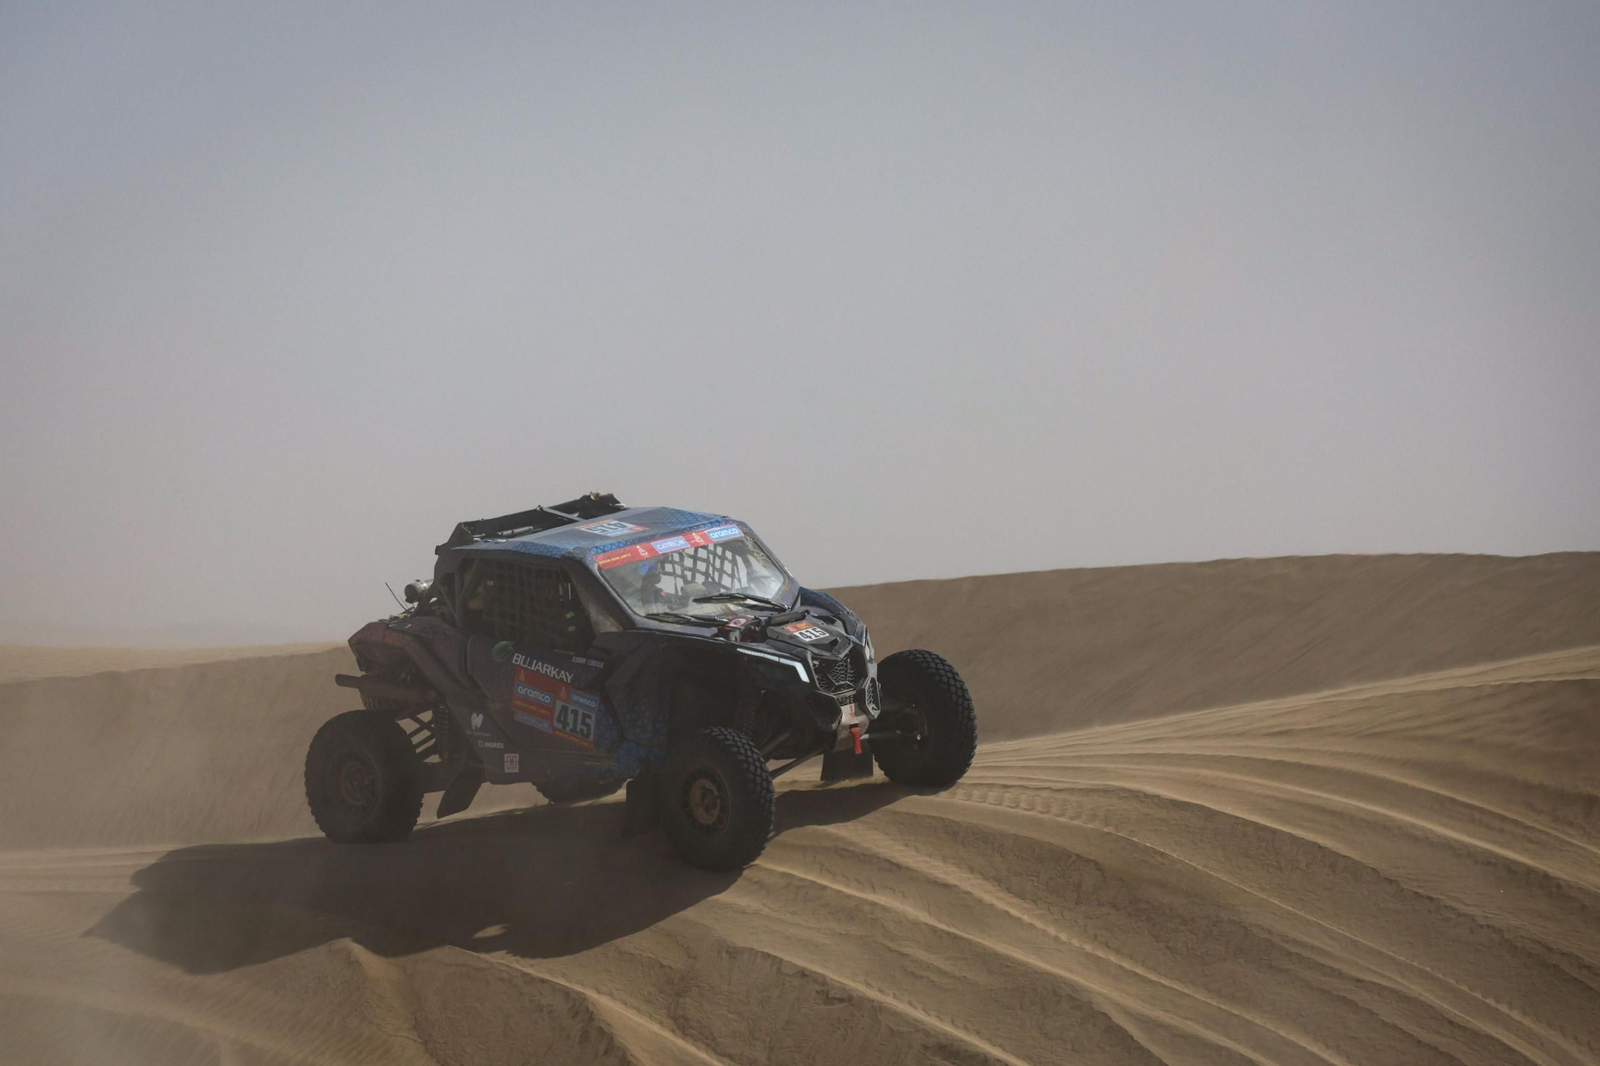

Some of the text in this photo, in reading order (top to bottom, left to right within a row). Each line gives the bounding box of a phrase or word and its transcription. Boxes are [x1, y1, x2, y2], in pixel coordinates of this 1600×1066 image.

[709, 528, 739, 539] aramco
[799, 628, 827, 640] 415
[517, 685, 551, 703] aramco
[571, 693, 596, 707] aramco
[556, 704, 592, 739] 415
